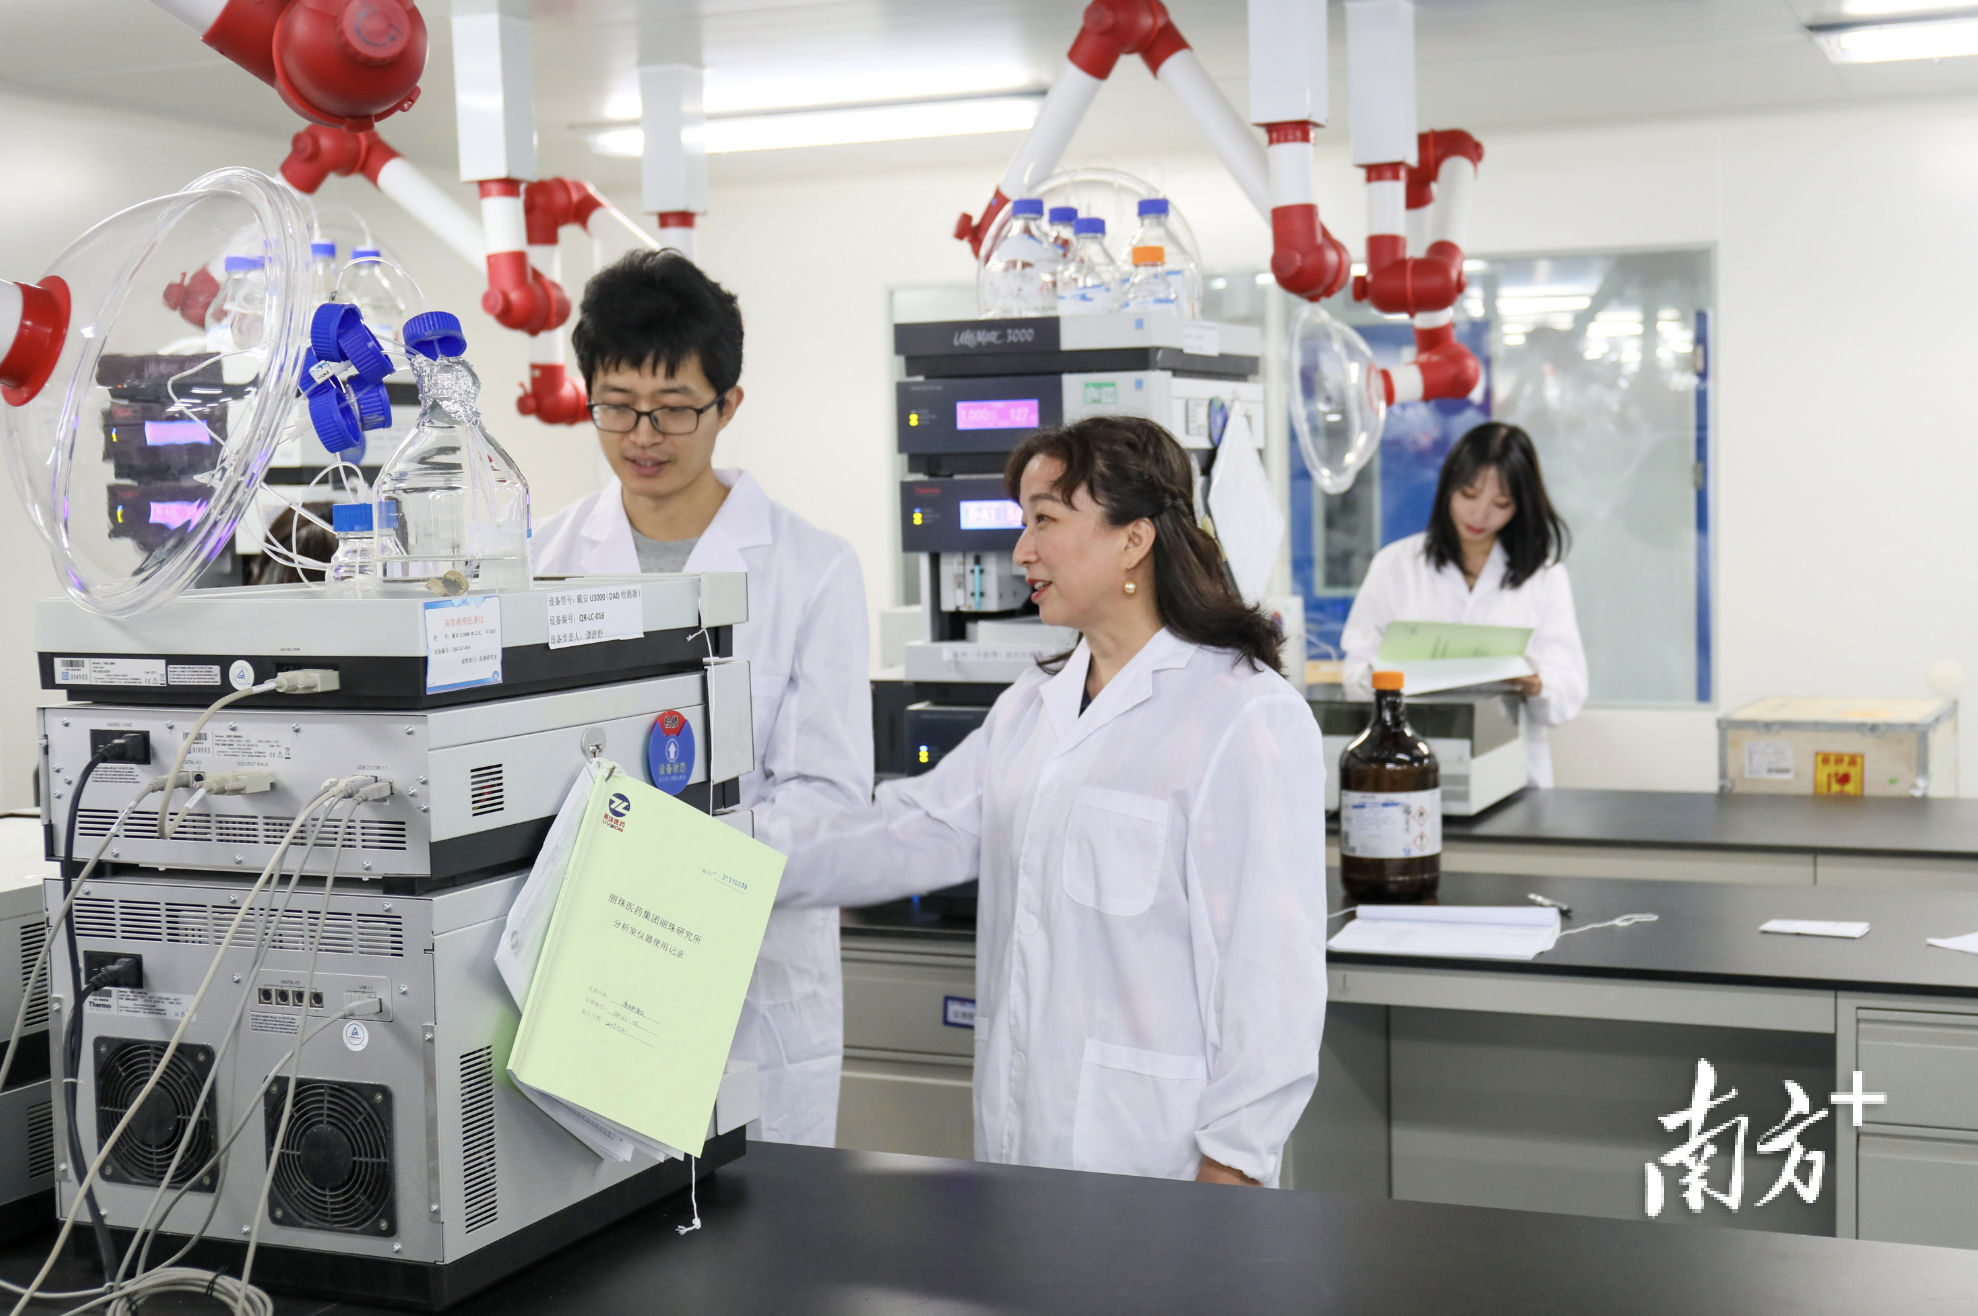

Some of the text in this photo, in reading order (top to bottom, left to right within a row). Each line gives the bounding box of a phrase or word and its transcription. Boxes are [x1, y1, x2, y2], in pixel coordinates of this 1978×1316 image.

[1006, 328, 1035, 343] 3000
[659, 762, 687, 775] 设备状态
[608, 893, 702, 945] 丽珠医药集团丽珠研究所
[613, 918, 685, 959] 分析室仪器使用记录
[88, 1001, 112, 1009] Thermo
